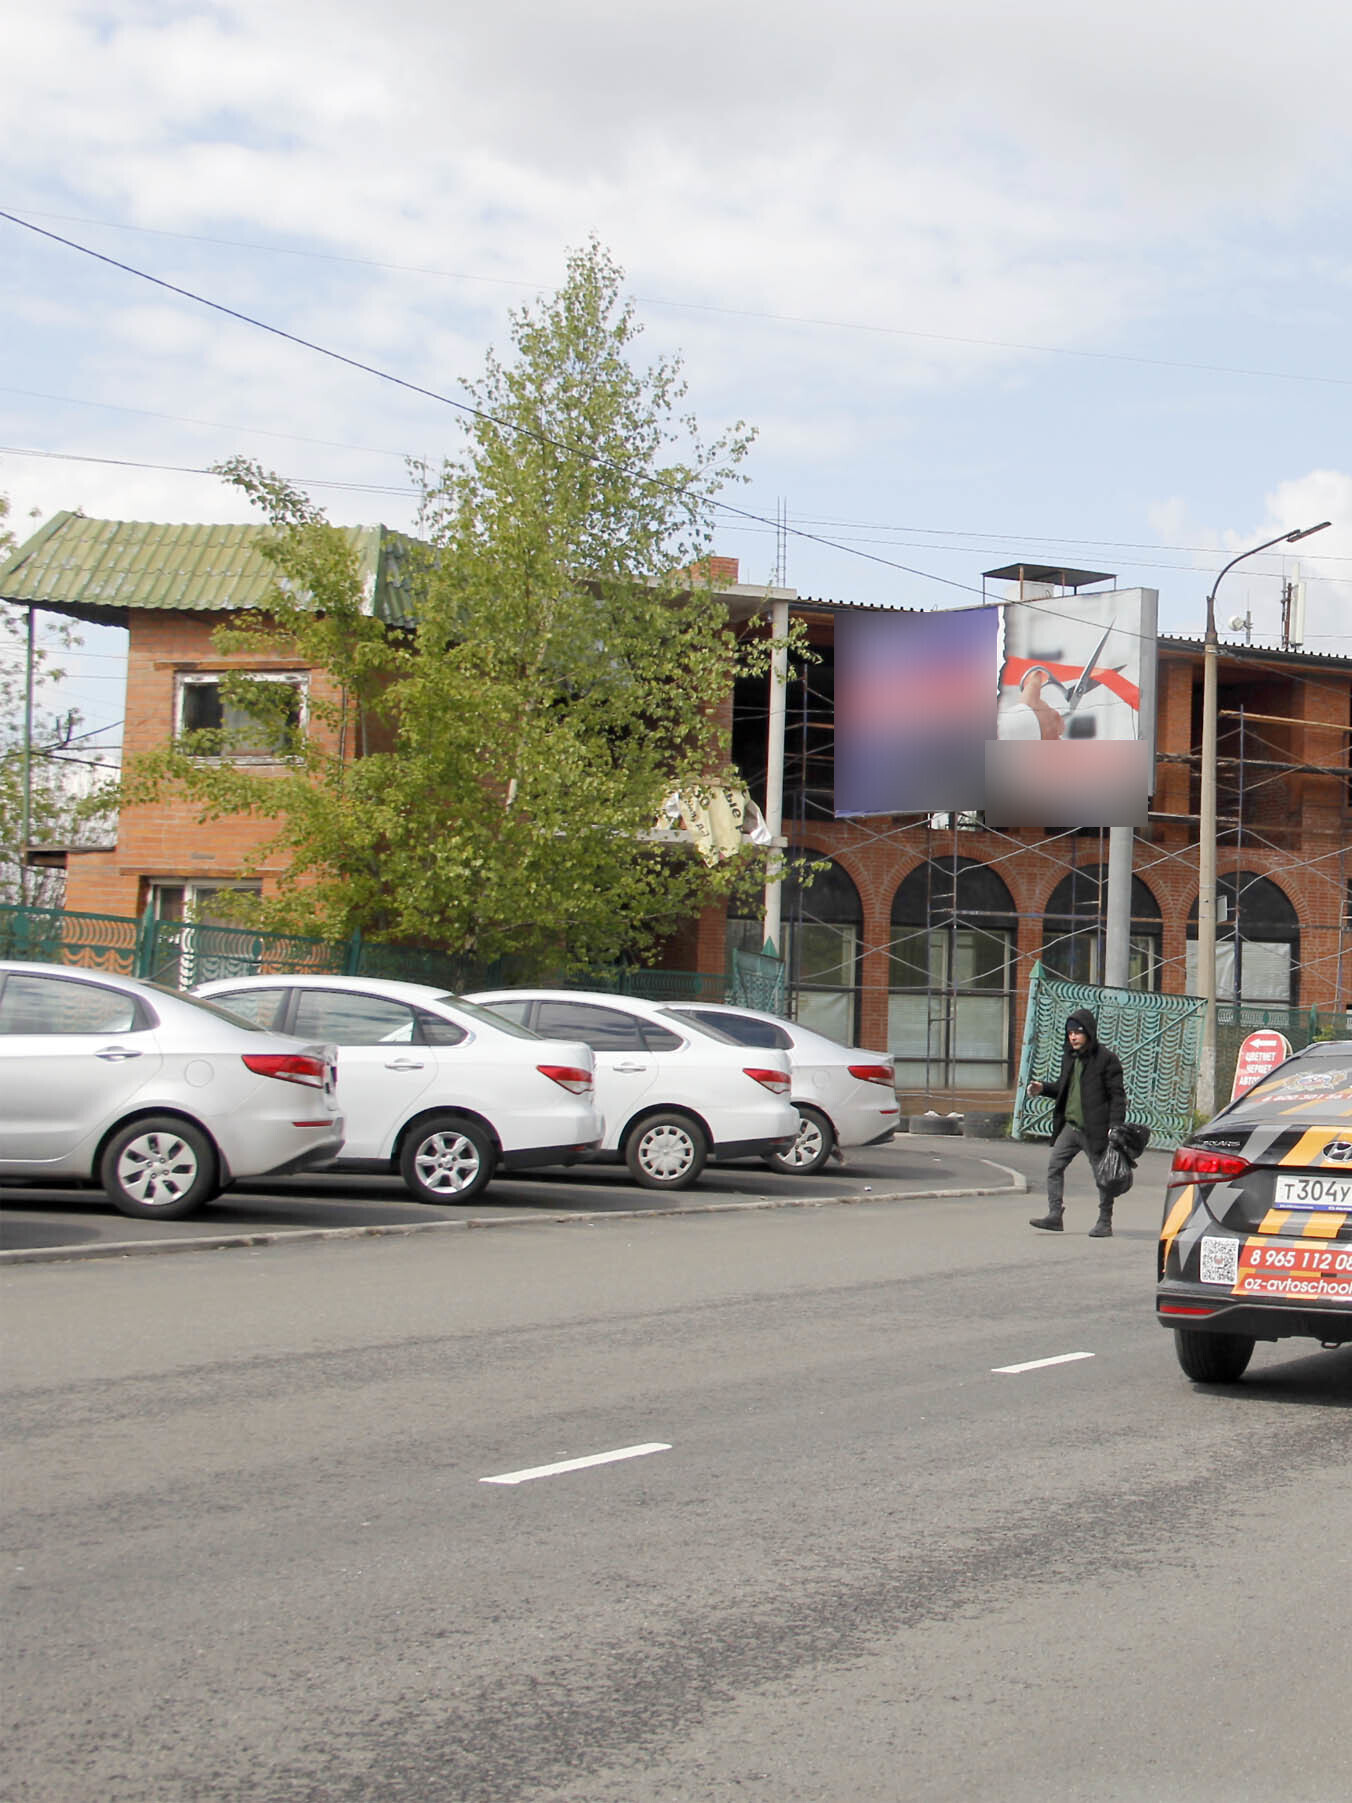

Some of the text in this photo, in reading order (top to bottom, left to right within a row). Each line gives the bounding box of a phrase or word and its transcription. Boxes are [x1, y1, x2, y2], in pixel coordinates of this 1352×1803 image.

[1250, 1249, 1261, 1265] 8
[1264, 1251, 1296, 1267] 965
[1301, 1252, 1332, 1270] 112
